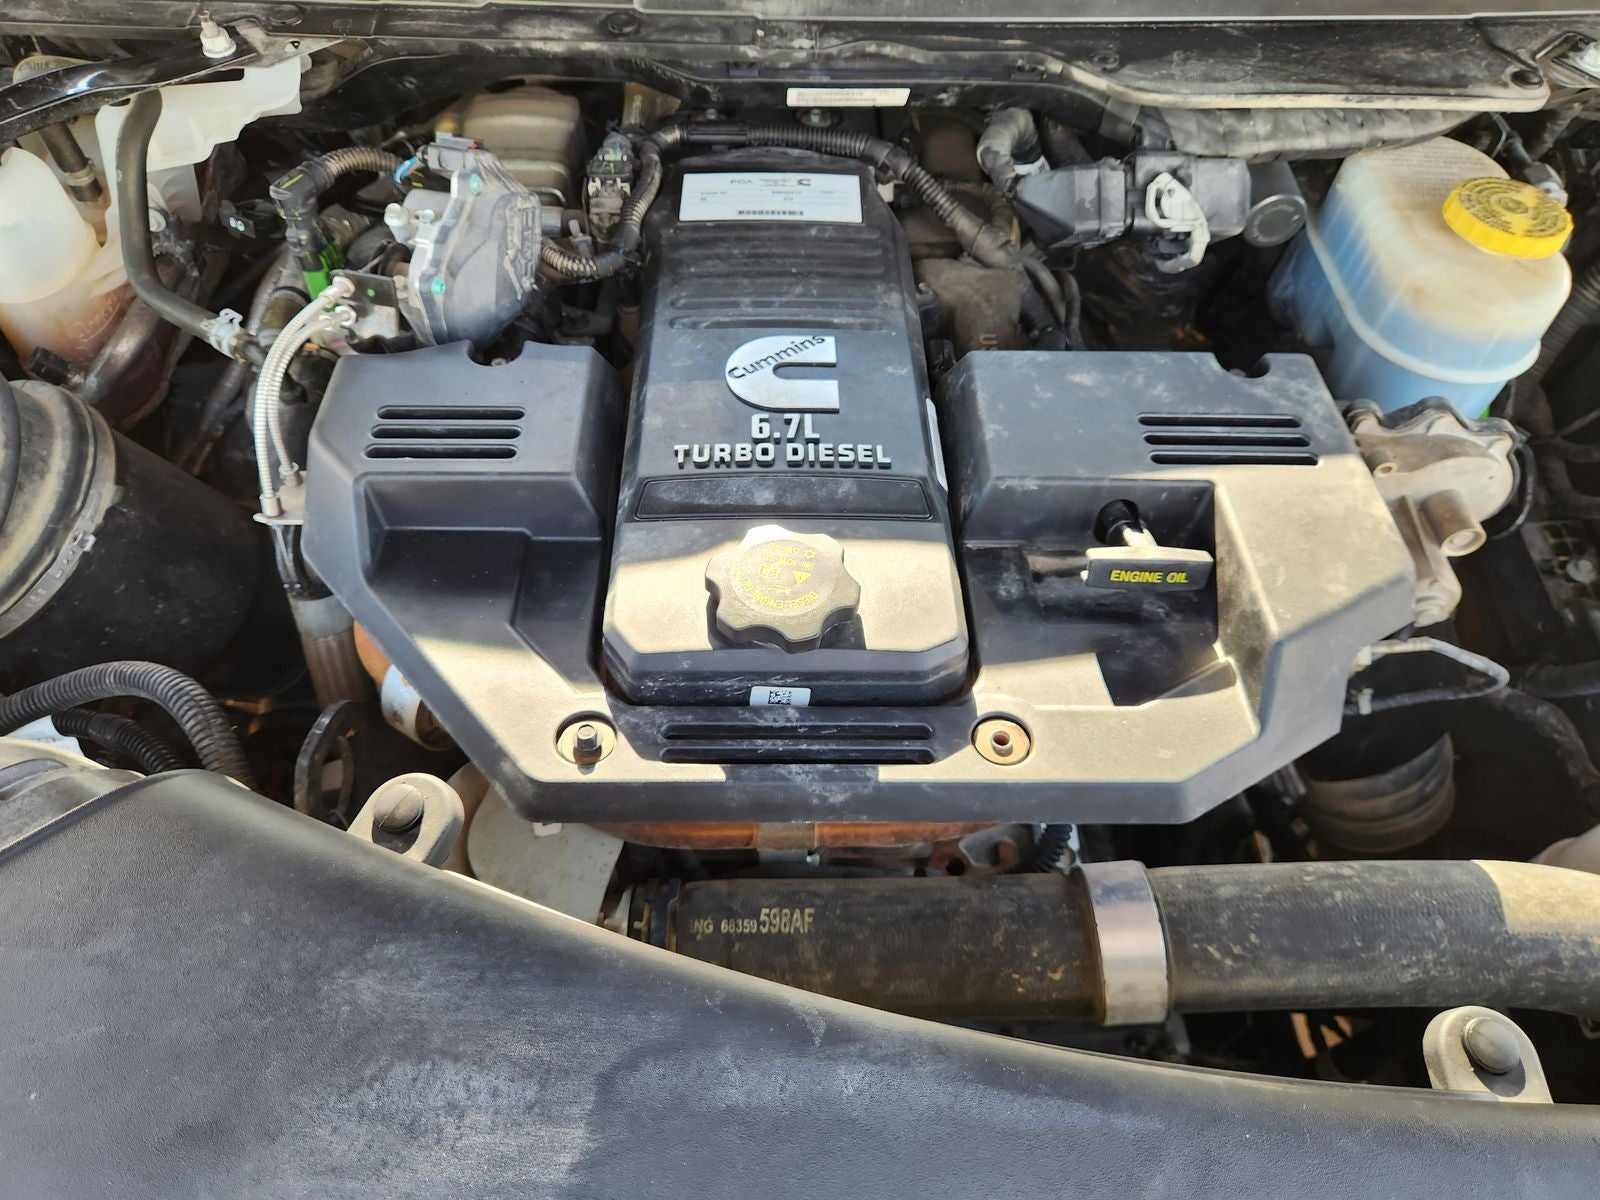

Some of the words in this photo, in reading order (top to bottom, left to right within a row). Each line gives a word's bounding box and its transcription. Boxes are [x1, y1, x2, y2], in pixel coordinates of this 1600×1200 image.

[727, 335, 826, 380] Cummins
[751, 413, 820, 444] 6.7L
[674, 443, 775, 469] TURBO
[786, 443, 892, 469] DIESEL
[1110, 570, 1164, 583] ENGINE
[1166, 572, 1188, 583] OIL
